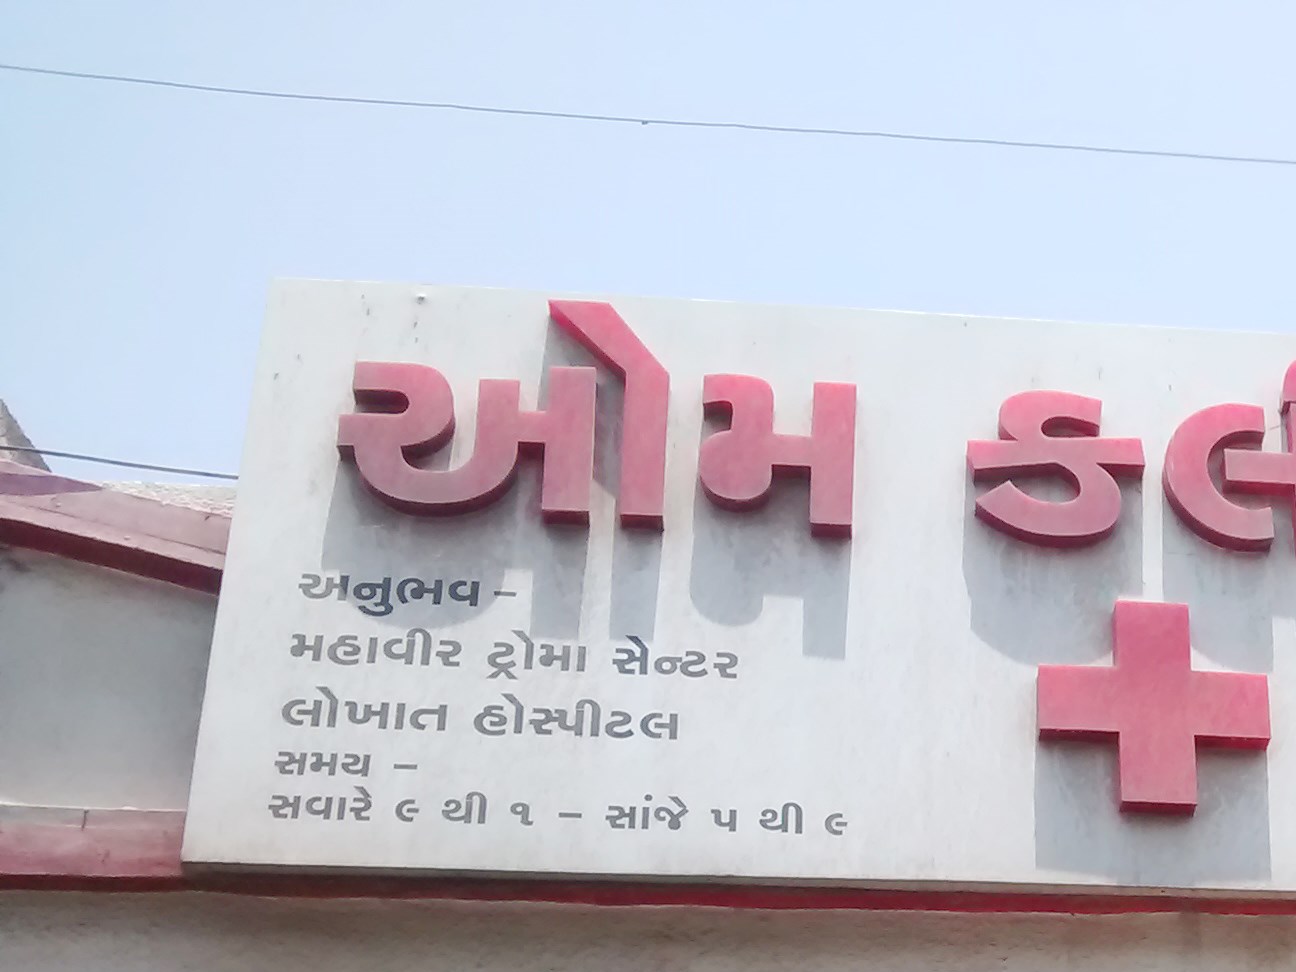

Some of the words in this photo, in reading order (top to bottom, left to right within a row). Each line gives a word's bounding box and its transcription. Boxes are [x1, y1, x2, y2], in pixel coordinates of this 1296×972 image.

[337, 300, 860, 536] ઓમ
[290, 627, 462, 667] મહાવીર
[486, 629, 587, 680] ટ્રોમા
[612, 635, 739, 679] સેન્ટર
[281, 686, 448, 732] લોખાત
[473, 693, 679, 740] હોસ્પીટલ
[274, 750, 371, 776] સમય
[268, 786, 373, 822] સવારે
[442, 791, 487, 824] થી
[605, 793, 689, 831] સાંજે
[759, 803, 803, 835] થી
